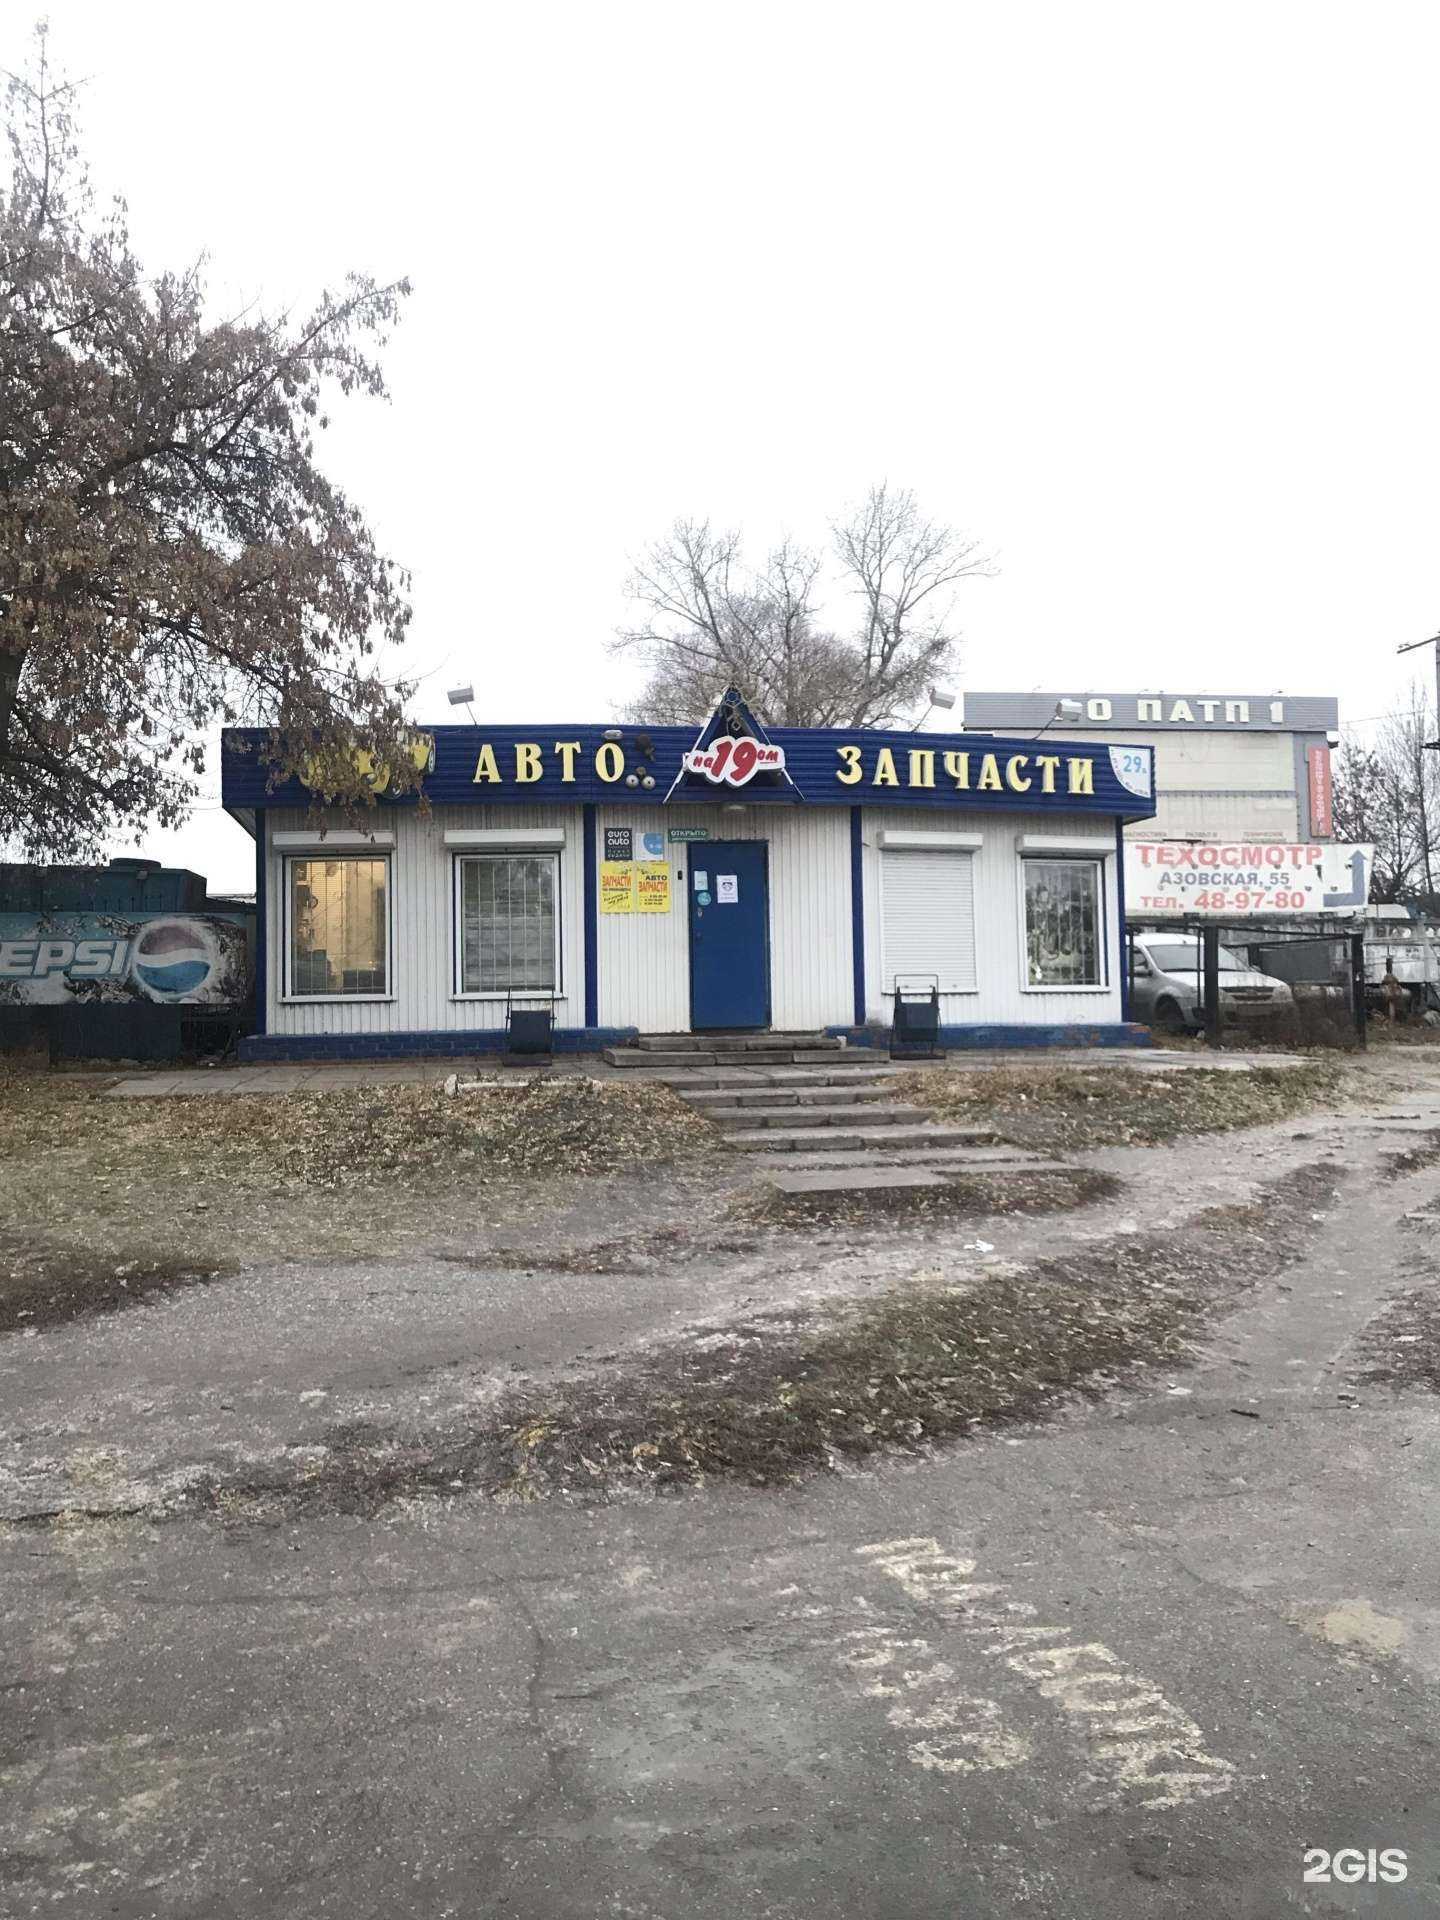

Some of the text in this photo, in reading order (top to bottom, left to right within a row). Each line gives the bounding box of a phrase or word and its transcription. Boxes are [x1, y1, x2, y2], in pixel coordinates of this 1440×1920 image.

[1138, 700, 1249, 723] ПАТП
[1271, 702, 1283, 723] 1
[473, 742, 625, 783] АВТО
[836, 745, 1094, 794] ЗАПЧАСТИ
[1136, 845, 1323, 866] ТЕХОСМОТР
[1161, 873, 1290, 887] АЗОВСКАЯ, 55
[1140, 892, 1305, 910] ТЕЛ. 48-97-80
[0, 940, 129, 976] EPSI
